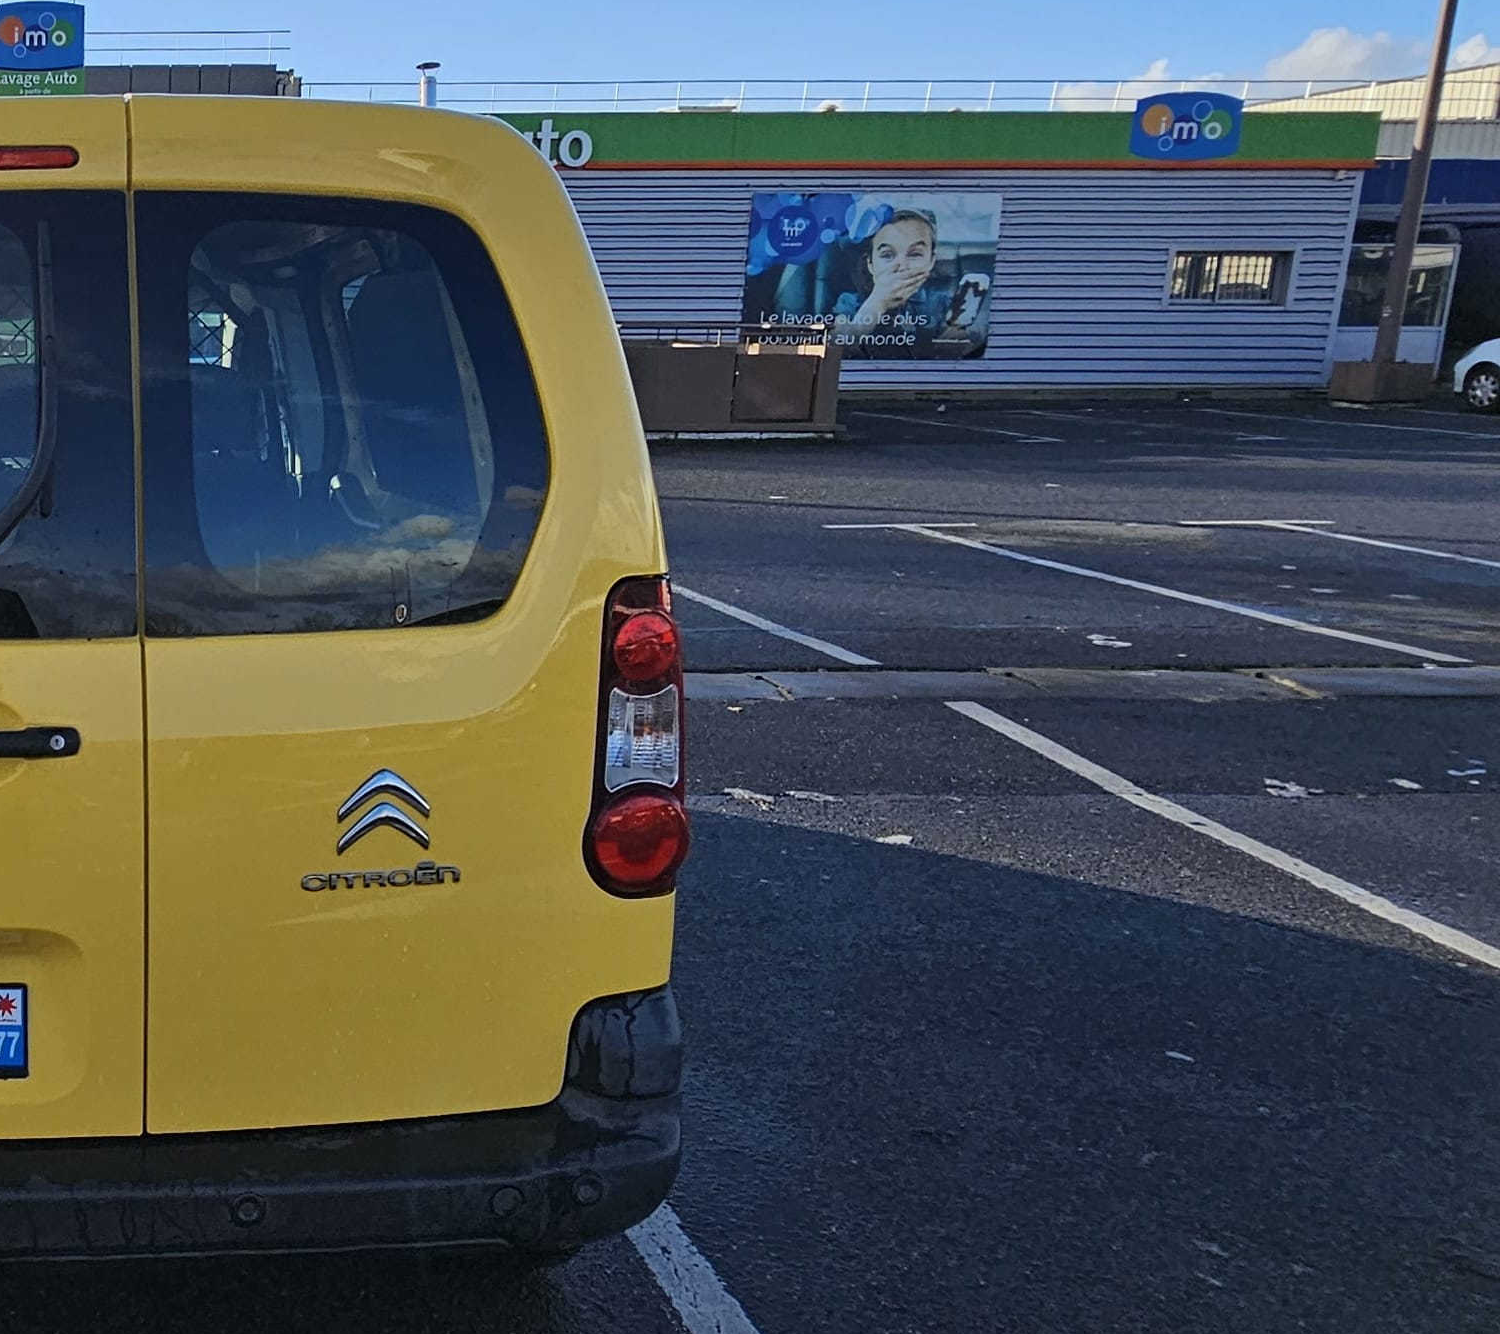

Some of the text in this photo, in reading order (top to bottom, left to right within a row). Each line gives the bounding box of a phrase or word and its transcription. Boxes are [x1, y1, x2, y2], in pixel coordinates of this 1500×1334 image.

[14, 26, 67, 47] imo
[45, 71, 77, 85] Auto
[1160, 116, 1222, 140] imo
[523, 119, 593, 167] to
[760, 310, 779, 324] Le
[835, 313, 873, 325] auto
[877, 310, 891, 325] le
[893, 310, 928, 328] plus
[835, 334, 855, 345] au
[859, 331, 916, 346] monde
